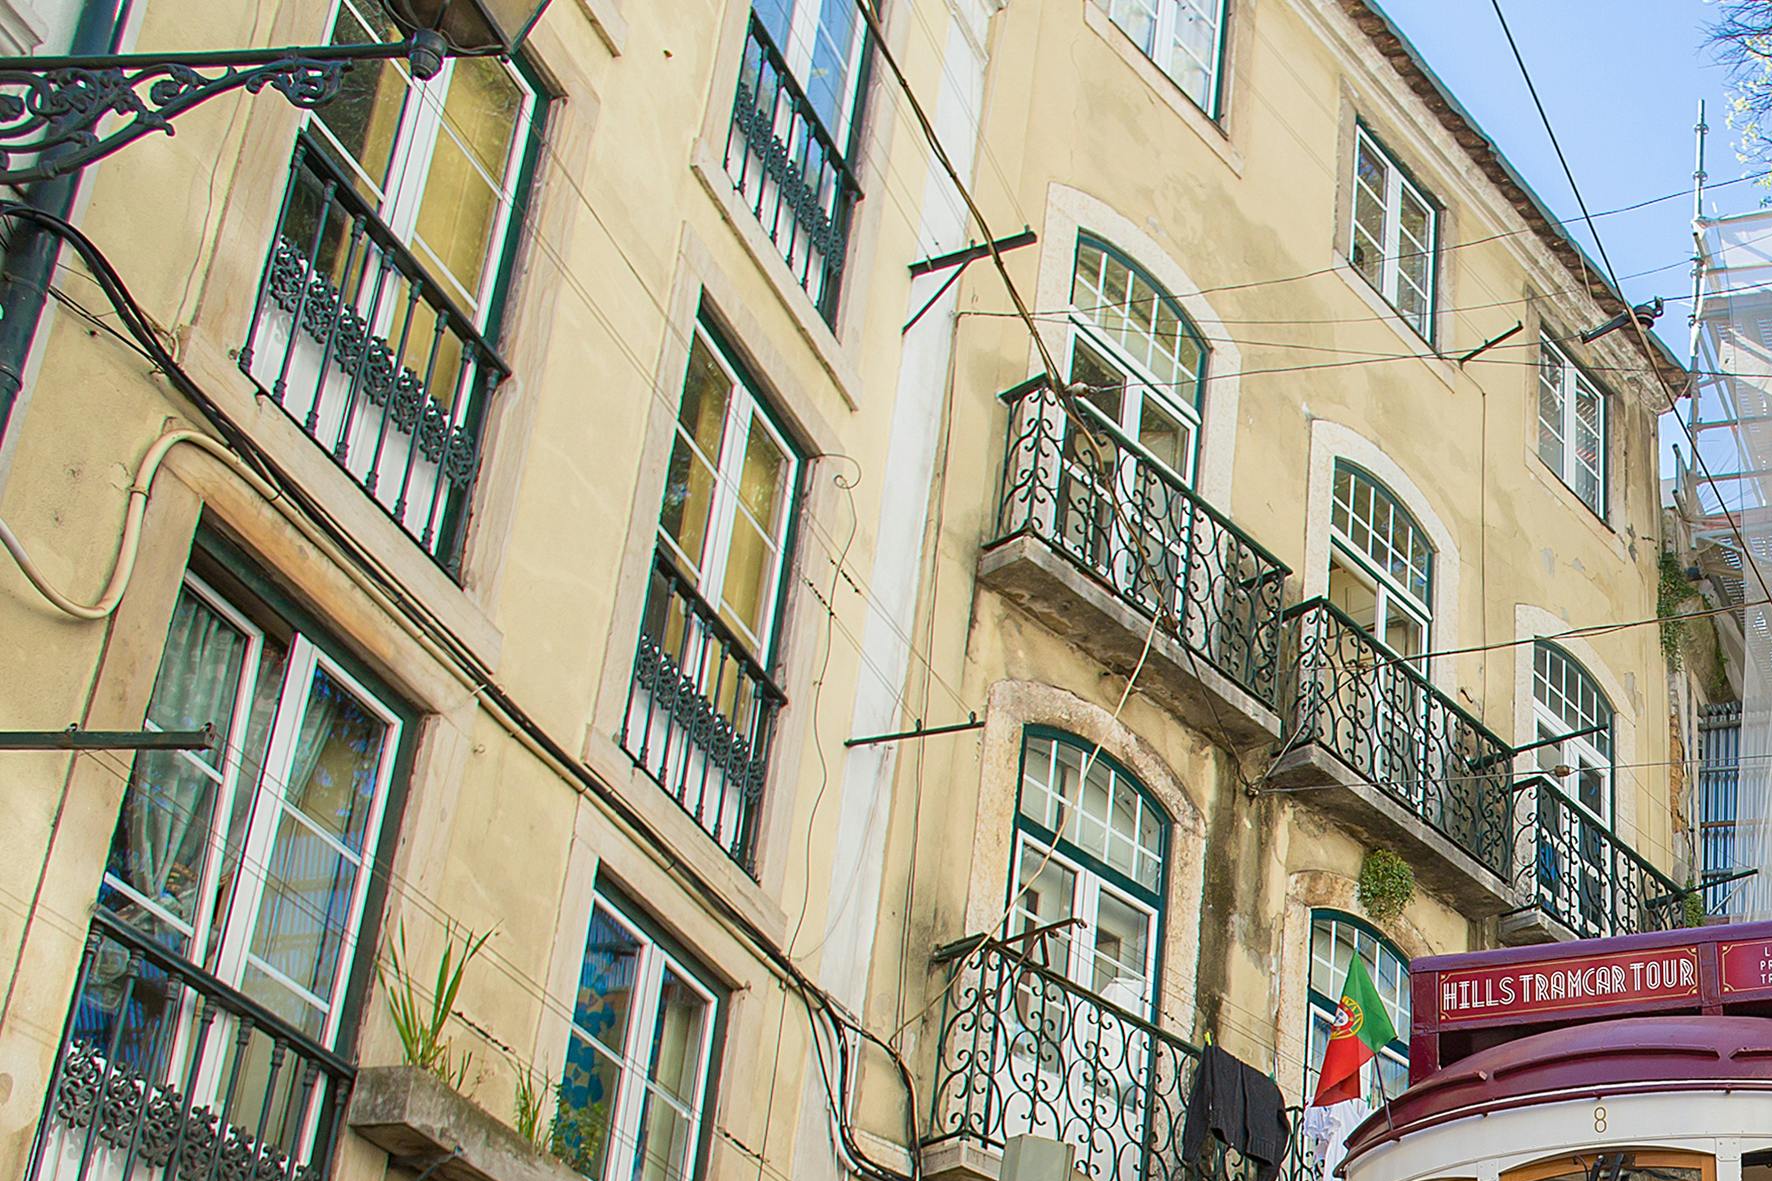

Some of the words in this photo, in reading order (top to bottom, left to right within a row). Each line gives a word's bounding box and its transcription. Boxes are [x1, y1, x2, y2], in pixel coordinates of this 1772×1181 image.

[1443, 976, 1516, 1011] HILLS
[1519, 965, 1627, 1003] TRAMCAR
[1630, 958, 1695, 991] TOUR
[1594, 1106, 1607, 1134] 8
